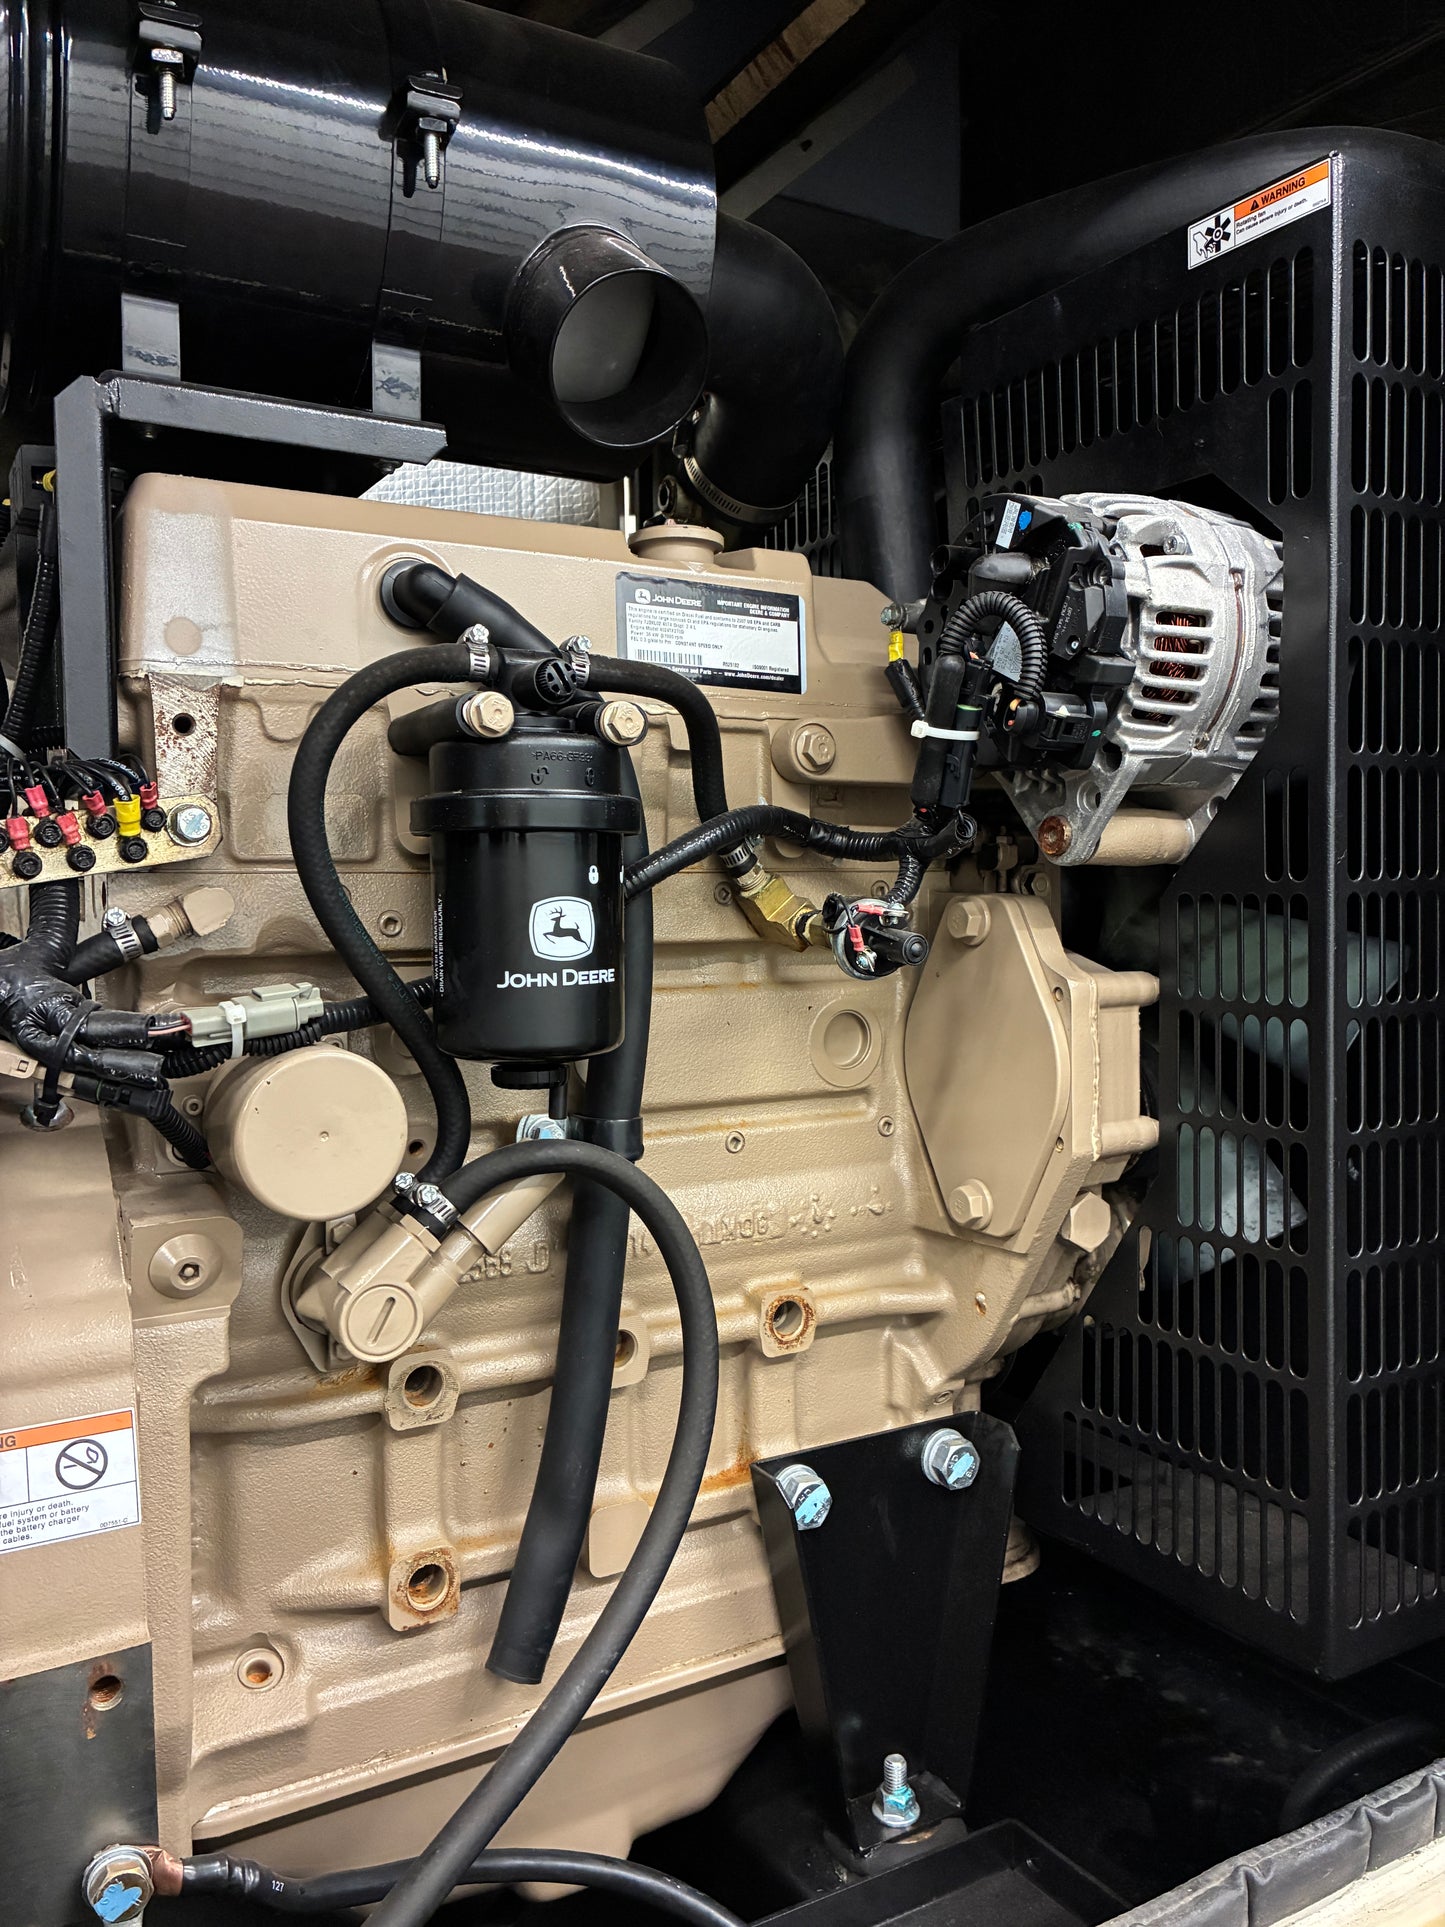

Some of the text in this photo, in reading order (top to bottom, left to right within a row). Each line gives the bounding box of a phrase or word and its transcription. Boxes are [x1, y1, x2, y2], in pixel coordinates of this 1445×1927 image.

[1261, 176, 1305, 205] WARNING
[1236, 215, 1257, 228] Rotating
[1245, 222, 1259, 231] cause
[1259, 214, 1274, 224] severe
[1274, 208, 1287, 217] injury
[652, 594, 702, 607] JOHN DEERE
[717, 600, 790, 612] IMPORTANT ENGINE INFORMATION
[769, 666, 789, 674] Registered
[437, 897, 445, 941] REGULARLY
[496, 967, 616, 989] JOHN DEERE
[10, 1507, 34, 1518] injury
[37, 1504, 46, 1513] or
[47, 1498, 74, 1510] death.
[17, 1513, 47, 1525] system
[49, 1510, 59, 1518] or
[60, 1503, 91, 1517] battery
[0, 1514, 80, 1537] the battery charger
[2, 1534, 33, 1545] cables.
[271, 1879, 285, 1893] 127
